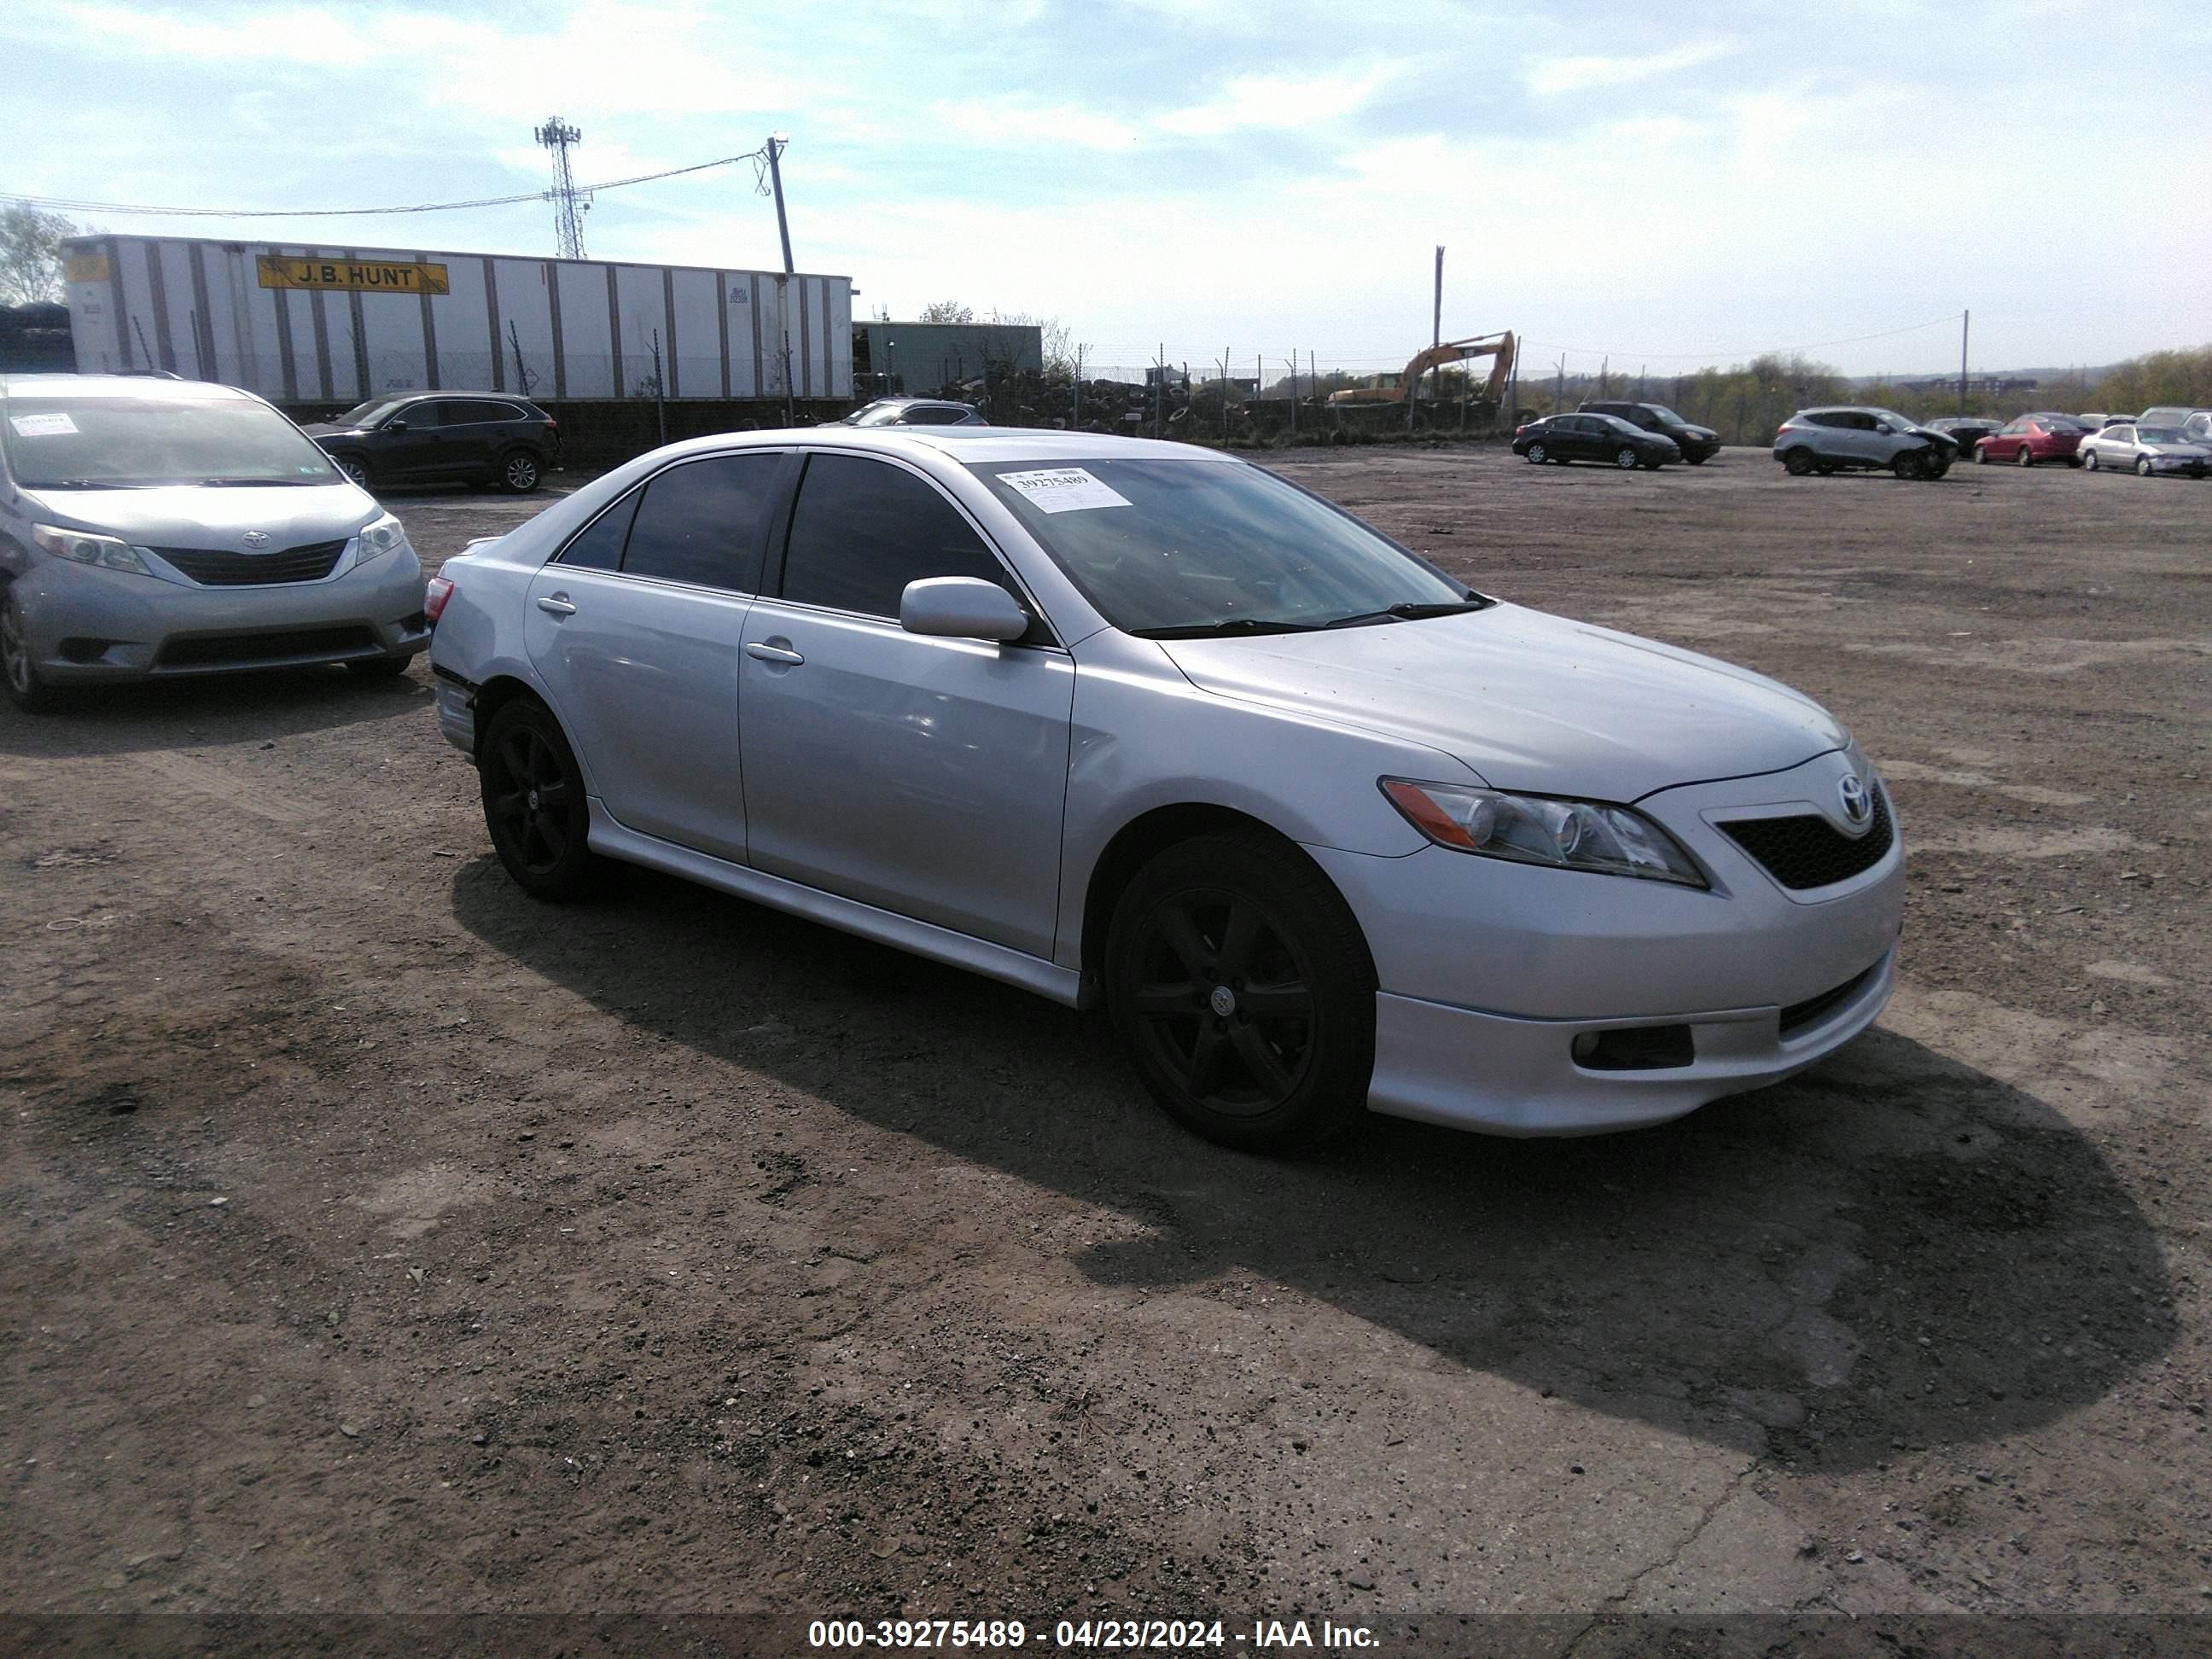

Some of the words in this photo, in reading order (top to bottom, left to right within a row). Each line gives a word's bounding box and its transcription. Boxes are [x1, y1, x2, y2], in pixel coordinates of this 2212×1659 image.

[300, 265, 342, 283] J.B.
[349, 265, 412, 286] HUNT
[1017, 475, 1089, 489] 39275489
